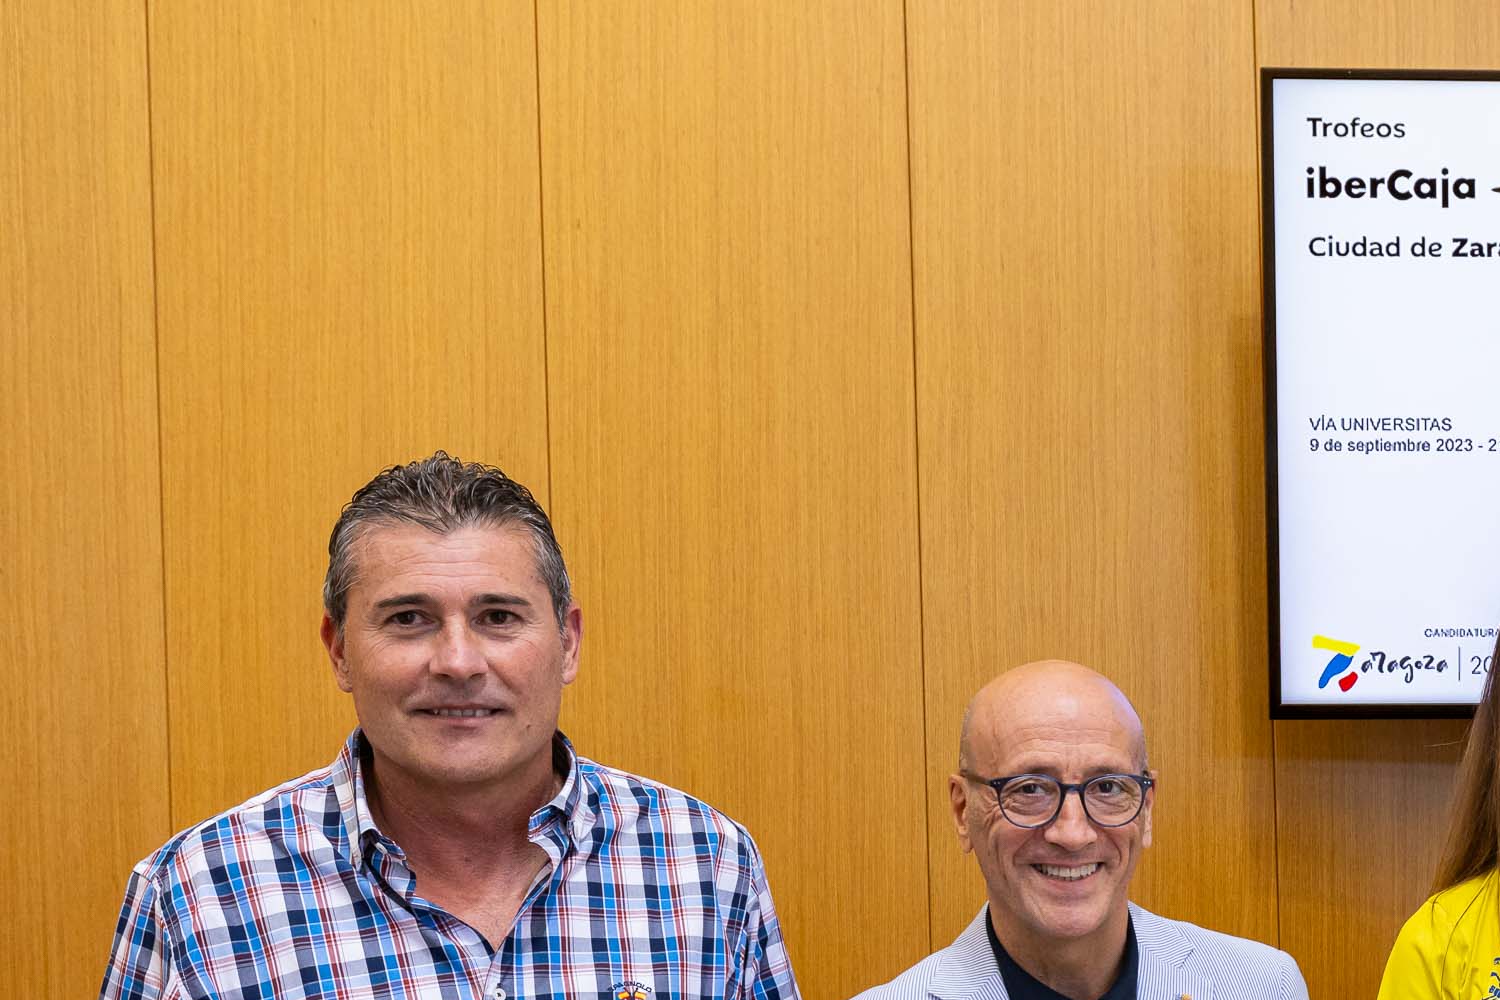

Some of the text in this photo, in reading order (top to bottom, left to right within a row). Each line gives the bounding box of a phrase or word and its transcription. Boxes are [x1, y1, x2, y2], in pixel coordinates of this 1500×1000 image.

[1306, 117, 1406, 138] Trofeos
[1306, 166, 1476, 209] iberCaja
[1309, 235, 1400, 258] Ciudad
[1411, 235, 1442, 257] de
[1309, 414, 1453, 432] VÍA UNIVERSITAS
[1310, 438, 1319, 452] 9
[1324, 438, 1342, 452] de
[1347, 438, 1431, 455] septiembre
[1436, 438, 1473, 452] 2023
